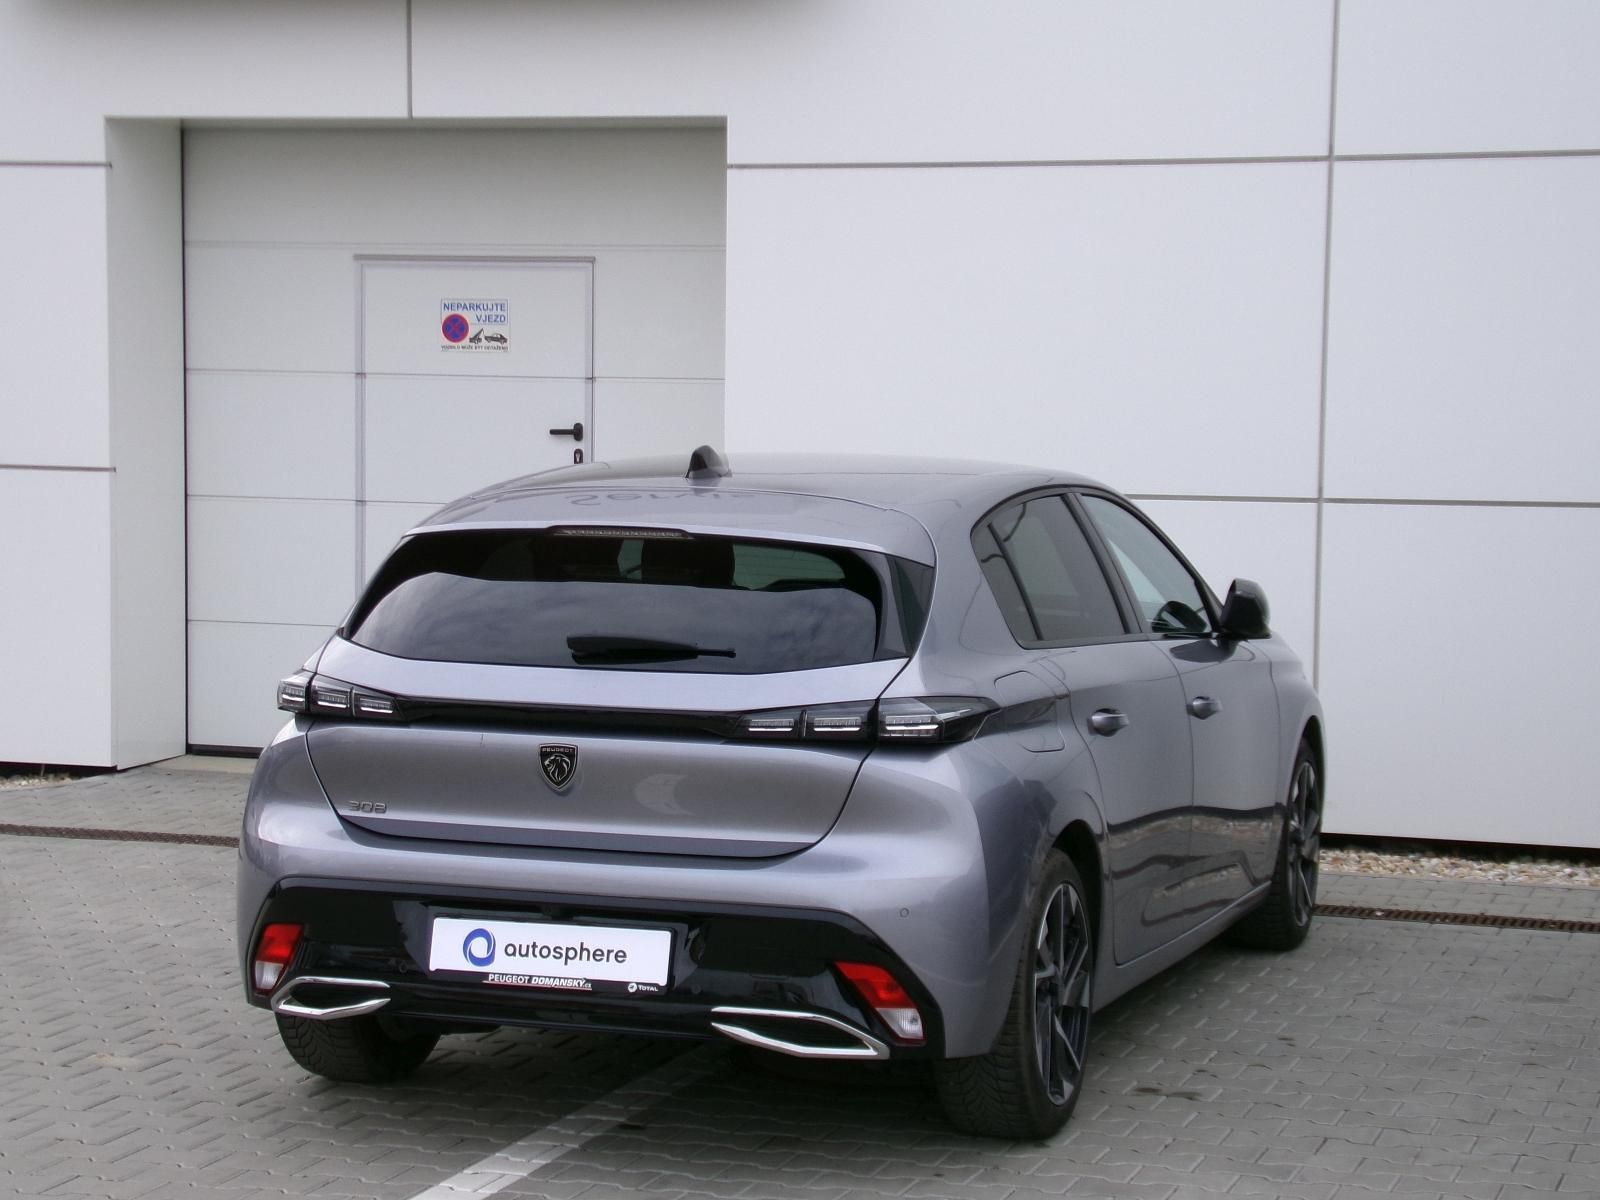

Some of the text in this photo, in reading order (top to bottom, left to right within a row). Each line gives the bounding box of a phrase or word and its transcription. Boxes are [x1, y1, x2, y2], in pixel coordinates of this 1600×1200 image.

[443, 302, 506, 311] NEPARKUJTE
[475, 314, 506, 323] VJEZD
[350, 800, 387, 814] 308
[504, 941, 628, 966] autosphere
[488, 973, 530, 984] PEUGEOT
